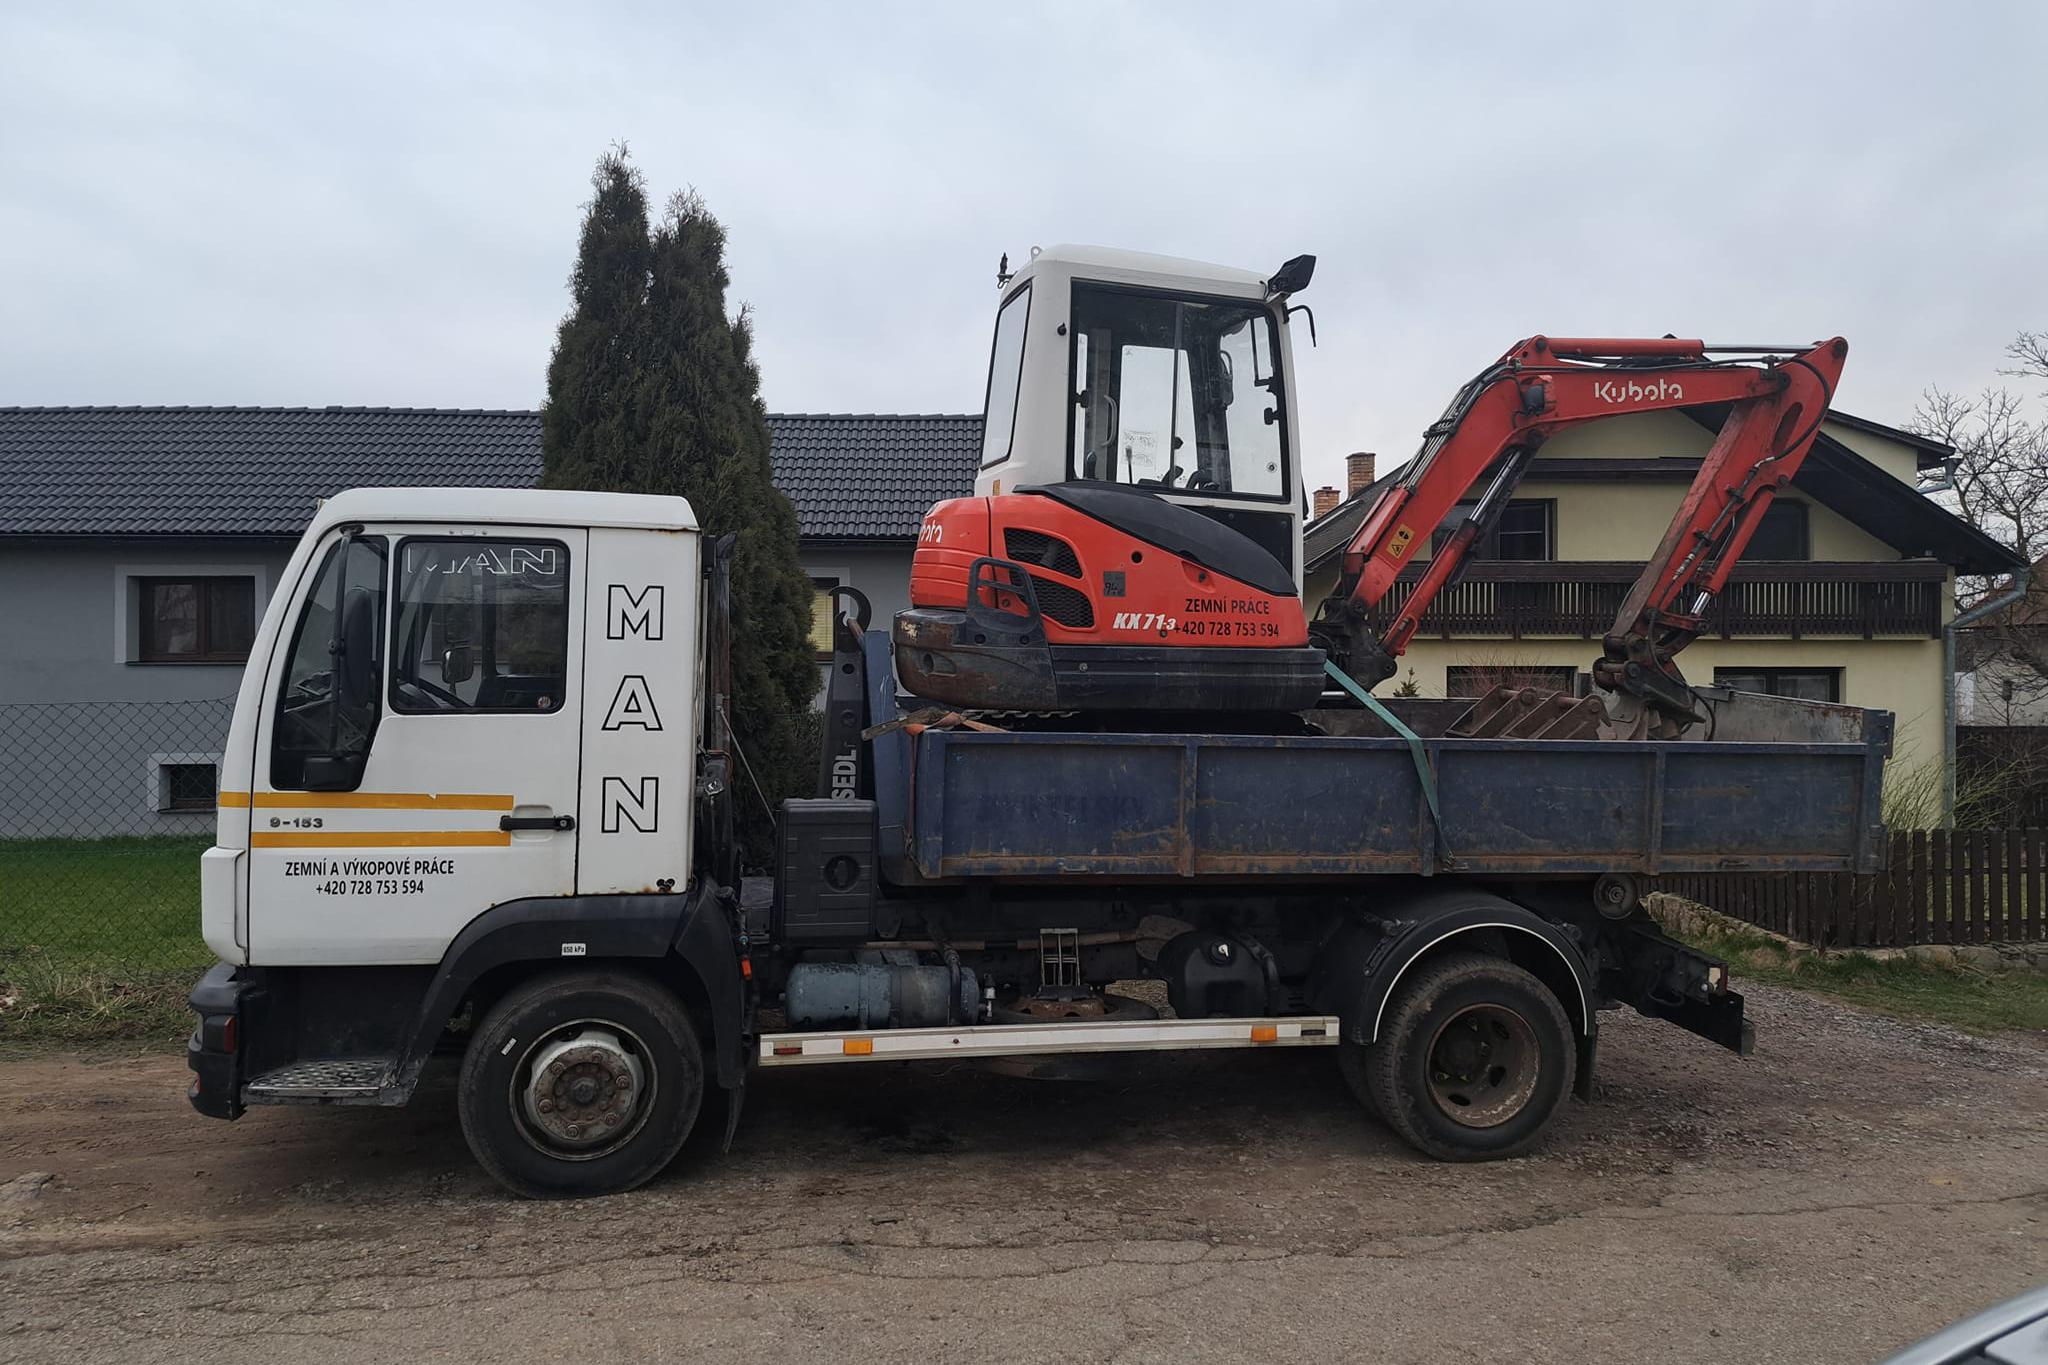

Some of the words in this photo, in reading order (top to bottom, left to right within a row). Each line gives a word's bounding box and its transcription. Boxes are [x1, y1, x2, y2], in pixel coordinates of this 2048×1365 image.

[1594, 378, 1683, 403] Kubota
[1185, 596, 1228, 614] ZEMNÍ
[1231, 597, 1270, 615] PRÁCE
[1174, 621, 1205, 635] +420
[1209, 621, 1231, 636] 728
[1236, 622, 1256, 637] 753
[1261, 622, 1280, 638] 594
[601, 584, 665, 834] MAN
[269, 816, 324, 829] 9-153
[285, 858, 328, 876] ZEMNÍ
[330, 862, 340, 876] A
[343, 857, 411, 876] VÝKOPOVÉ
[414, 857, 454, 875] PRÁCE
[316, 881, 346, 895] +420
[350, 880, 372, 895] 728
[376, 880, 398, 894] 753
[402, 879, 424, 894] 594
